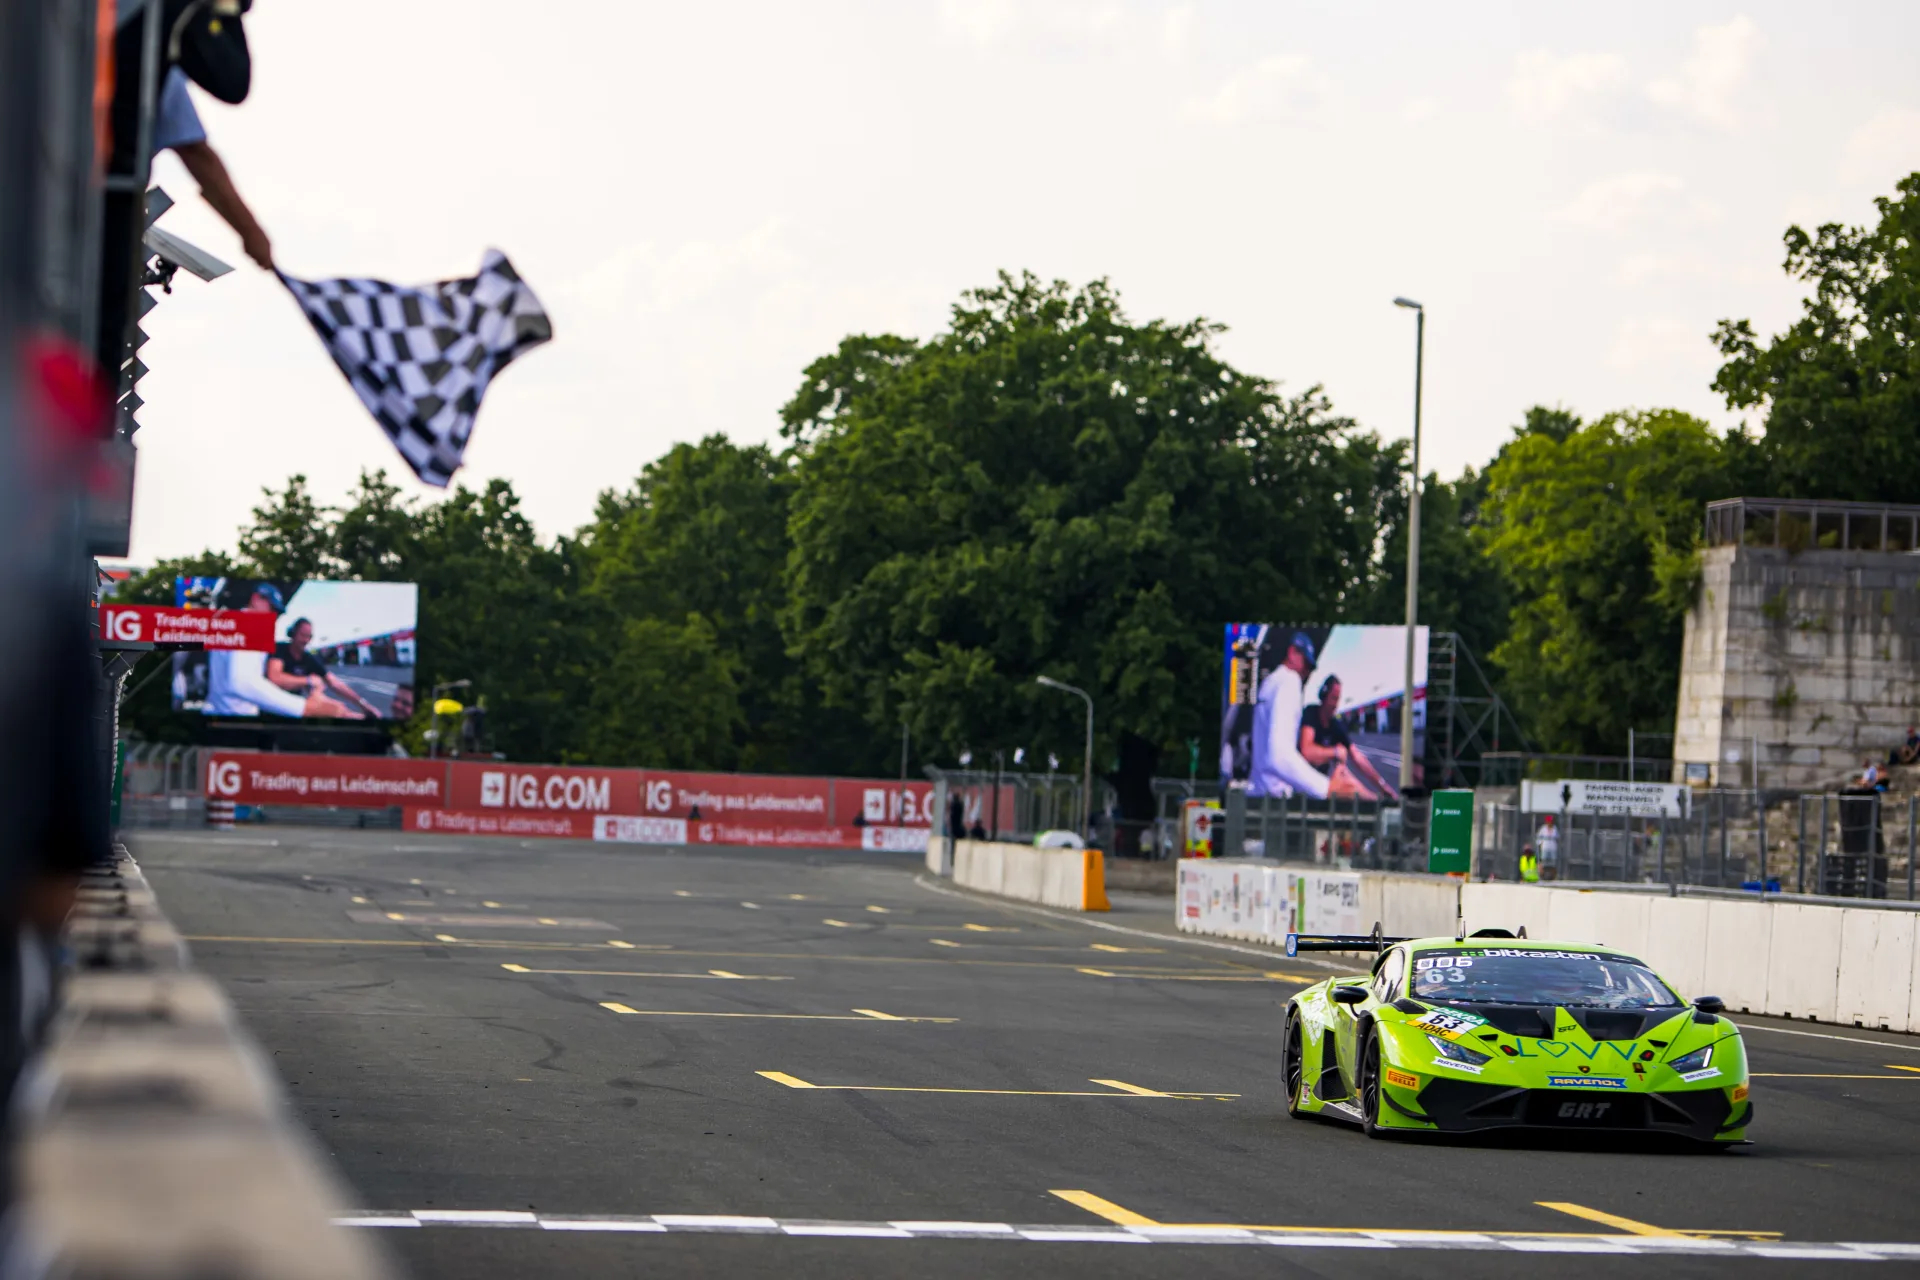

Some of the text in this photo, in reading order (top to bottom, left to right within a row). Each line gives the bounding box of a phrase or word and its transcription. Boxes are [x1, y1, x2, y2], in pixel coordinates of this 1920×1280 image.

[106, 610, 142, 641] IG
[155, 612, 236, 630] Trading aus
[154, 629, 247, 647] Leidenschaft
[207, 760, 439, 796] IG Trading aus Leidenschaft
[509, 773, 611, 810] IG.COM
[646, 780, 824, 813] IG Trading aus Leidenschaft
[1482, 949, 1601, 961] bitkasten
[1425, 967, 1466, 983] 63
[1429, 1014, 1464, 1030] 63
[1434, 1006, 1485, 1025] DEKRA
[1416, 1022, 1451, 1037] ADAC
[1437, 1058, 1477, 1072] RAVENOL
[1387, 1070, 1416, 1087] PIRELLI
[1554, 1078, 1621, 1087] RAVENOL
[1558, 1102, 1612, 1118] GRT
